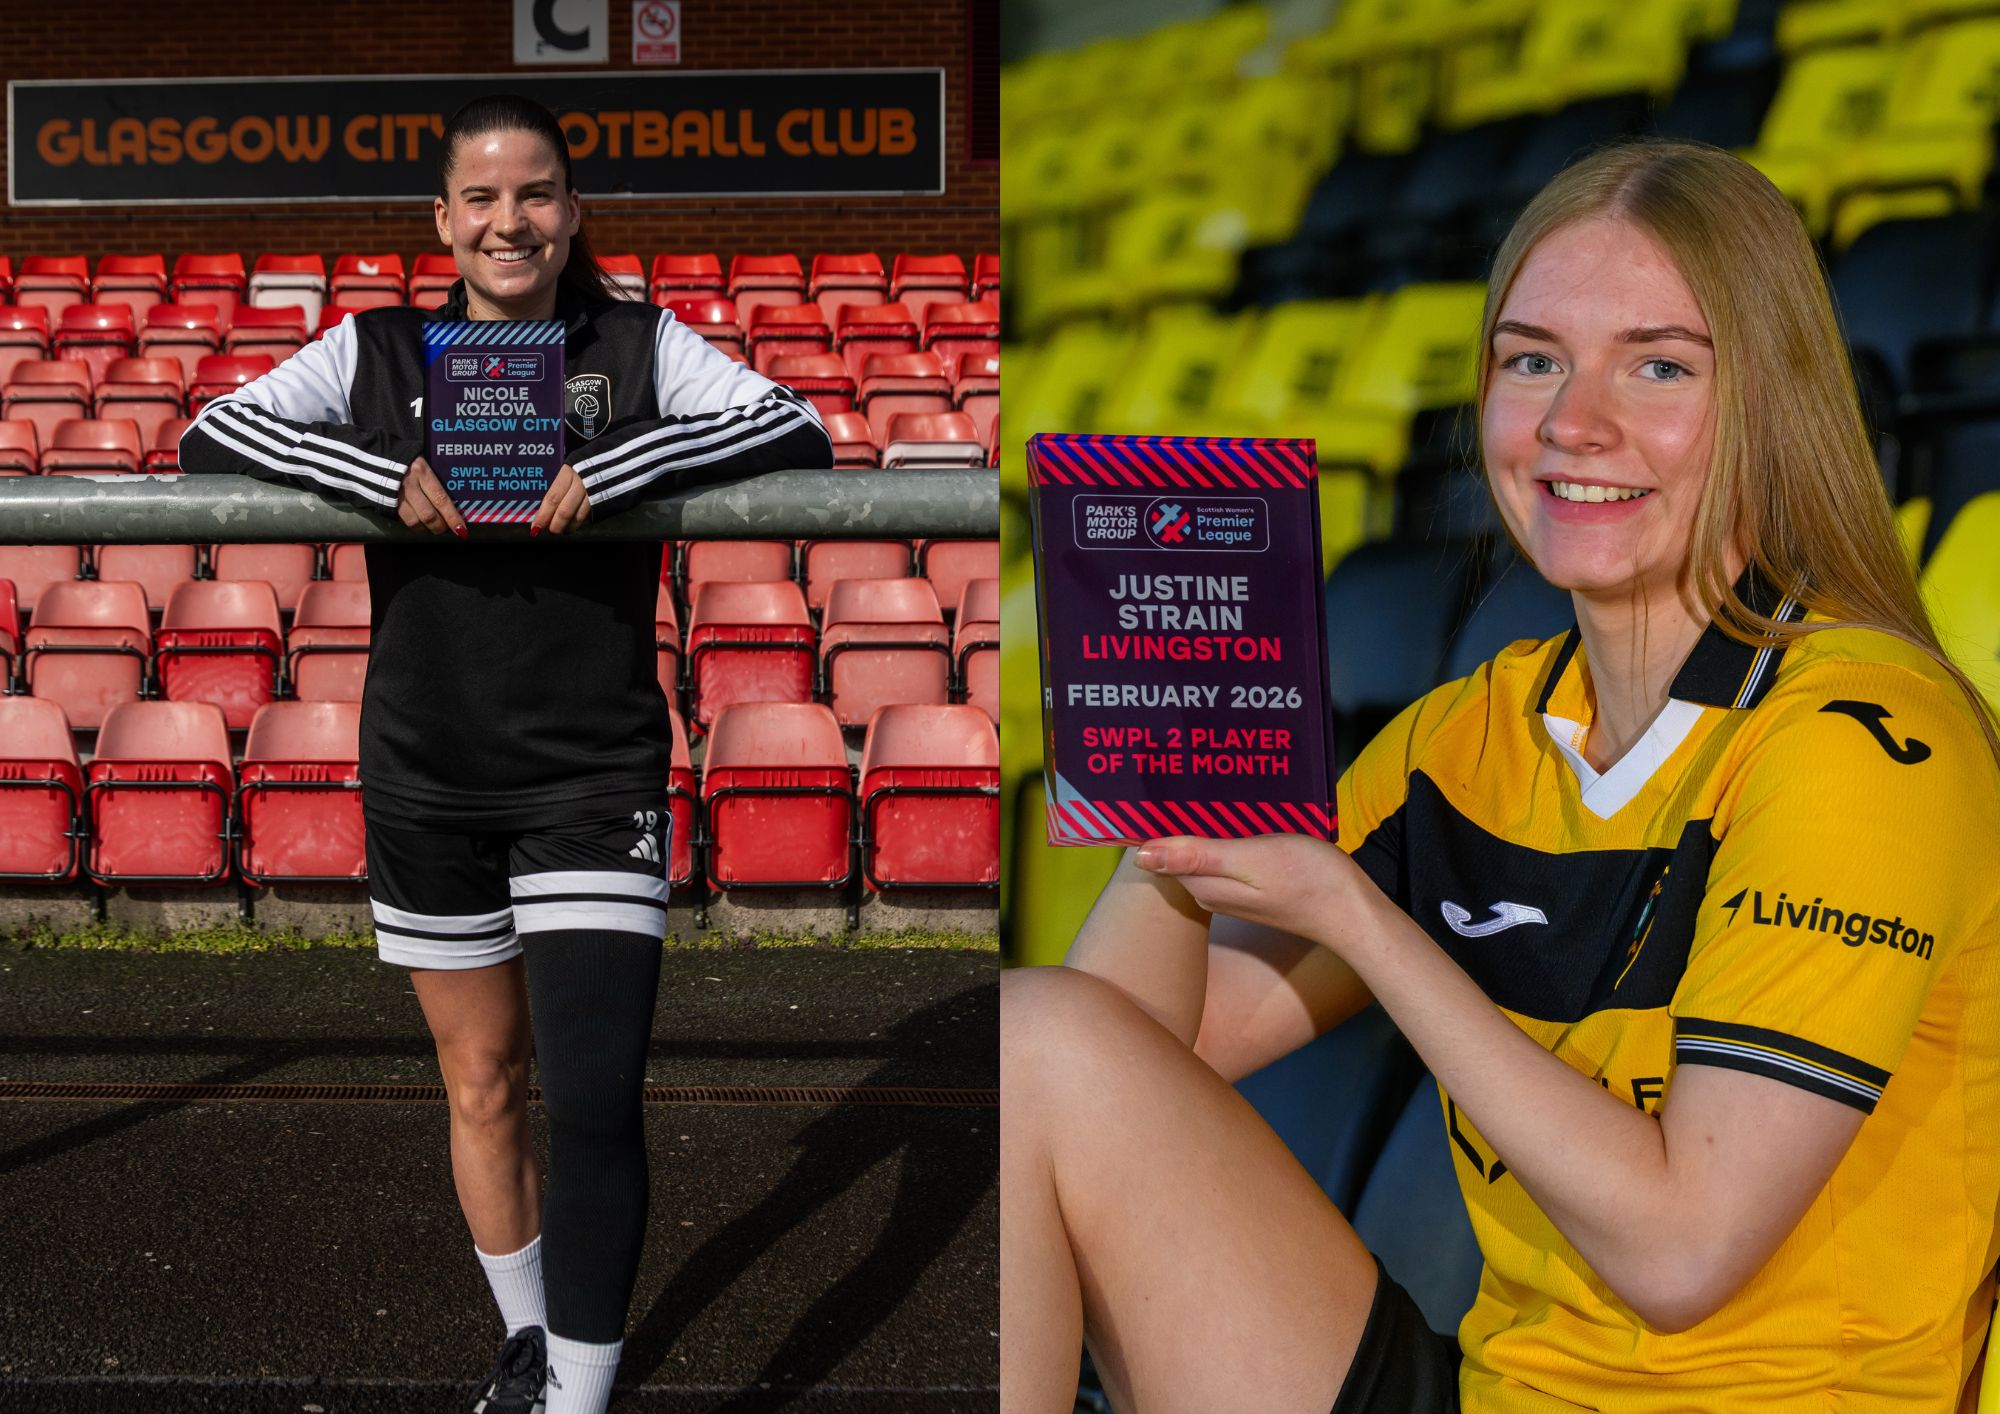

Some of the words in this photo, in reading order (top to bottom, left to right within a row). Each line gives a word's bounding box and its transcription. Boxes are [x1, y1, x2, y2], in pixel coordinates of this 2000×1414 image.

[37, 114, 330, 166] GLASGOW
[559, 109, 766, 160] OTBALL
[776, 108, 917, 156] CLUB
[507, 361, 538, 369] Premier
[507, 369, 536, 377] League
[566, 379, 602, 389] GLASGOW
[464, 387, 529, 400] NICOLE
[456, 402, 537, 416] KOZLOVA
[431, 418, 517, 432] GLASGOW
[522, 418, 561, 432] CITY
[436, 444, 513, 456] FEBRUARY
[518, 444, 555, 456] 2026
[451, 467, 488, 478] SWPL
[493, 467, 544, 478] PLAYER
[447, 480, 465, 491] OF
[470, 480, 495, 491] THE
[498, 480, 548, 491] MONTH
[1086, 505, 1136, 517] PARK'S
[1086, 516, 1138, 528] MOTOR
[1197, 515, 1255, 527] Premier
[1087, 528, 1136, 540] GROUP
[1197, 529, 1252, 544] League
[1109, 574, 1249, 601] JUSTINE
[1118, 604, 1243, 630] STRAIN
[1082, 635, 1281, 661] LIVINGSTON
[1067, 684, 1220, 707] FEBRUARY
[1231, 686, 1302, 709] 2026
[1082, 727, 1158, 748] SWPL
[1167, 728, 1183, 748] 2
[1191, 728, 1292, 750] PLAYER
[1087, 753, 1123, 774] OF
[1132, 753, 1183, 774] THE
[1193, 754, 1289, 775] MONTH
[1753, 890, 1934, 961] Livingston
